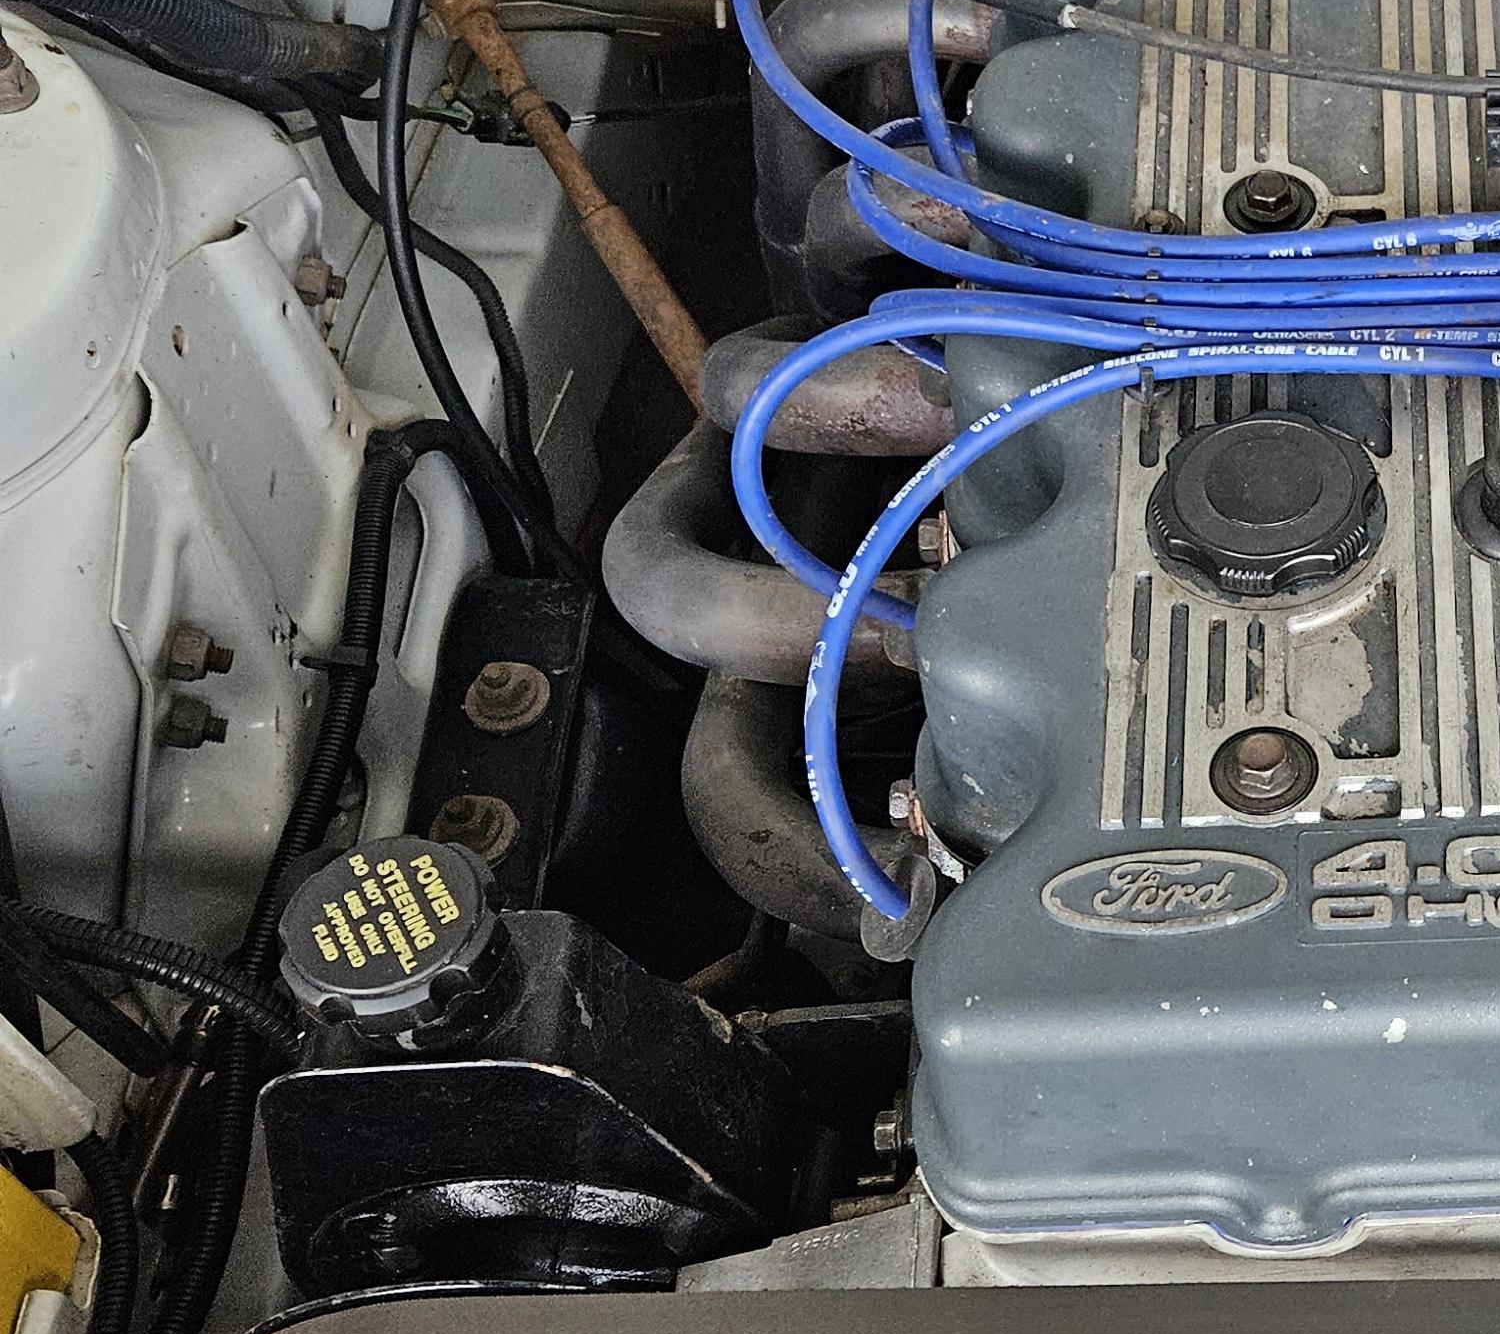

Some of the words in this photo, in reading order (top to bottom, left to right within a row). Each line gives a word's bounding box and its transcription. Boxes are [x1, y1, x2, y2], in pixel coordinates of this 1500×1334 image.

[1372, 234, 1403, 250] CYL
[1406, 233, 1417, 246] 6
[1350, 330, 1380, 341] CYL
[1384, 330, 1395, 341] 2
[969, 408, 1001, 435] CYL
[1001, 401, 1014, 419] 1
[1029, 362, 1095, 397] HI-TEMP
[1102, 349, 1179, 371] SILICONE
[1305, 345, 1359, 356] CABLE
[1380, 345, 1412, 361] CYL
[1416, 348, 1424, 361] 1
[853, 522, 881, 559] mm
[348, 854, 370, 877] DO
[361, 878, 386, 907] NOT
[378, 911, 418, 975] OVERFILL
[377, 858, 436, 951] STEERING
[410, 854, 460, 925] POWER
[1091, 861, 1237, 917] Ford
[312, 924, 339, 962] FLUID
[323, 901, 367, 968] APPROVED
[343, 890, 367, 920] USE
[360, 923, 386, 956] ONLY
